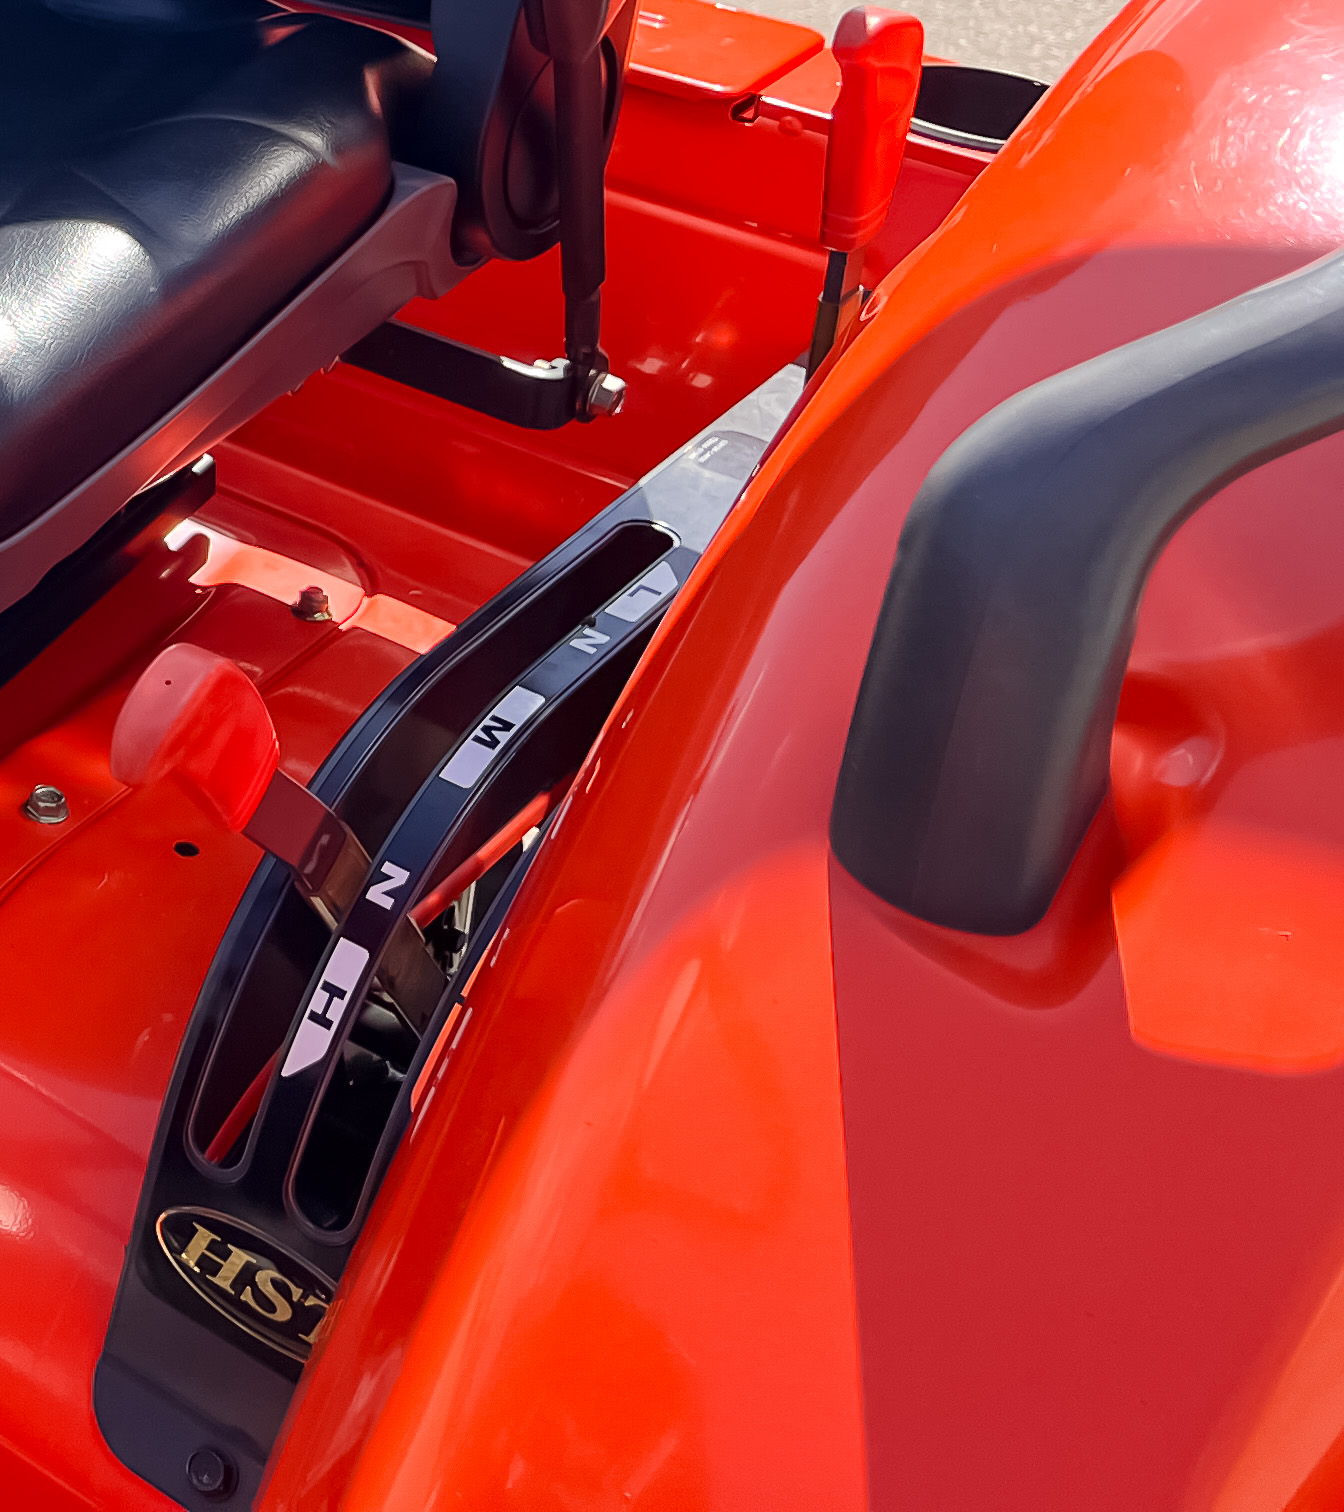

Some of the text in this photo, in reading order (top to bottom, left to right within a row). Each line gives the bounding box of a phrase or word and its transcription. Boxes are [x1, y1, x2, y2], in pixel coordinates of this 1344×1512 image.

[627, 584, 662, 598] L
[569, 627, 611, 655] N
[471, 714, 516, 751] M
[365, 861, 410, 911] N
[307, 979, 347, 1031] H
